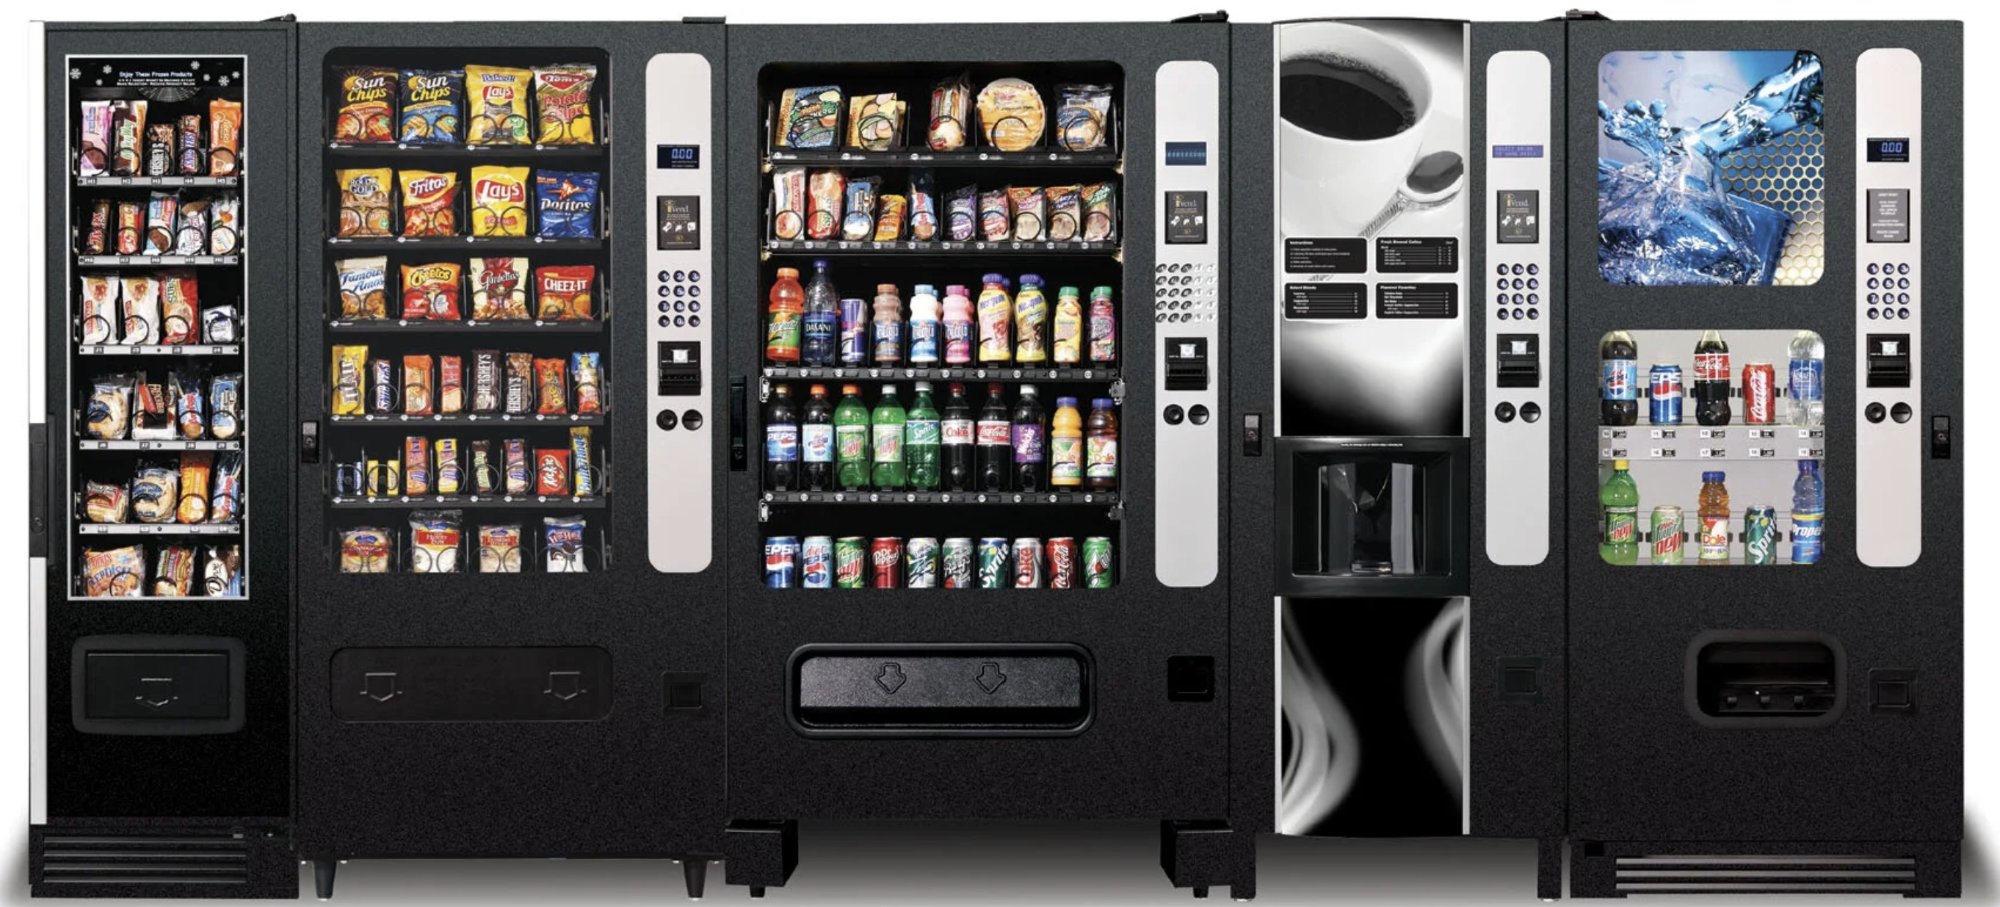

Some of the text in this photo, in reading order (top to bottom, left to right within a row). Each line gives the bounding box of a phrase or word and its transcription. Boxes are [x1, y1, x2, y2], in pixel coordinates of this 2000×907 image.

[354, 76, 386, 90] Sun
[417, 75, 448, 89] Sun
[347, 87, 387, 102] Chips
[411, 86, 451, 102] Chips
[543, 91, 587, 108] Potato
[671, 148, 693, 160] 0.00
[1881, 142, 1903, 153] 0.00
[409, 178, 447, 195] Fritos
[540, 198, 592, 212] Doritos
[410, 268, 452, 288] Cheetos
[544, 278, 587, 292] CHEEZ-IT
[805, 323, 831, 332] DASANI
[478, 353, 491, 394] HERSHEY'S
[1651, 372, 1681, 383] EPS
[768, 432, 796, 441] PEPS
[914, 423, 936, 437] Sprite
[1793, 524, 1823, 538] Prope
[1703, 534, 1726, 545] Dole
[979, 543, 1008, 588] Sprite
